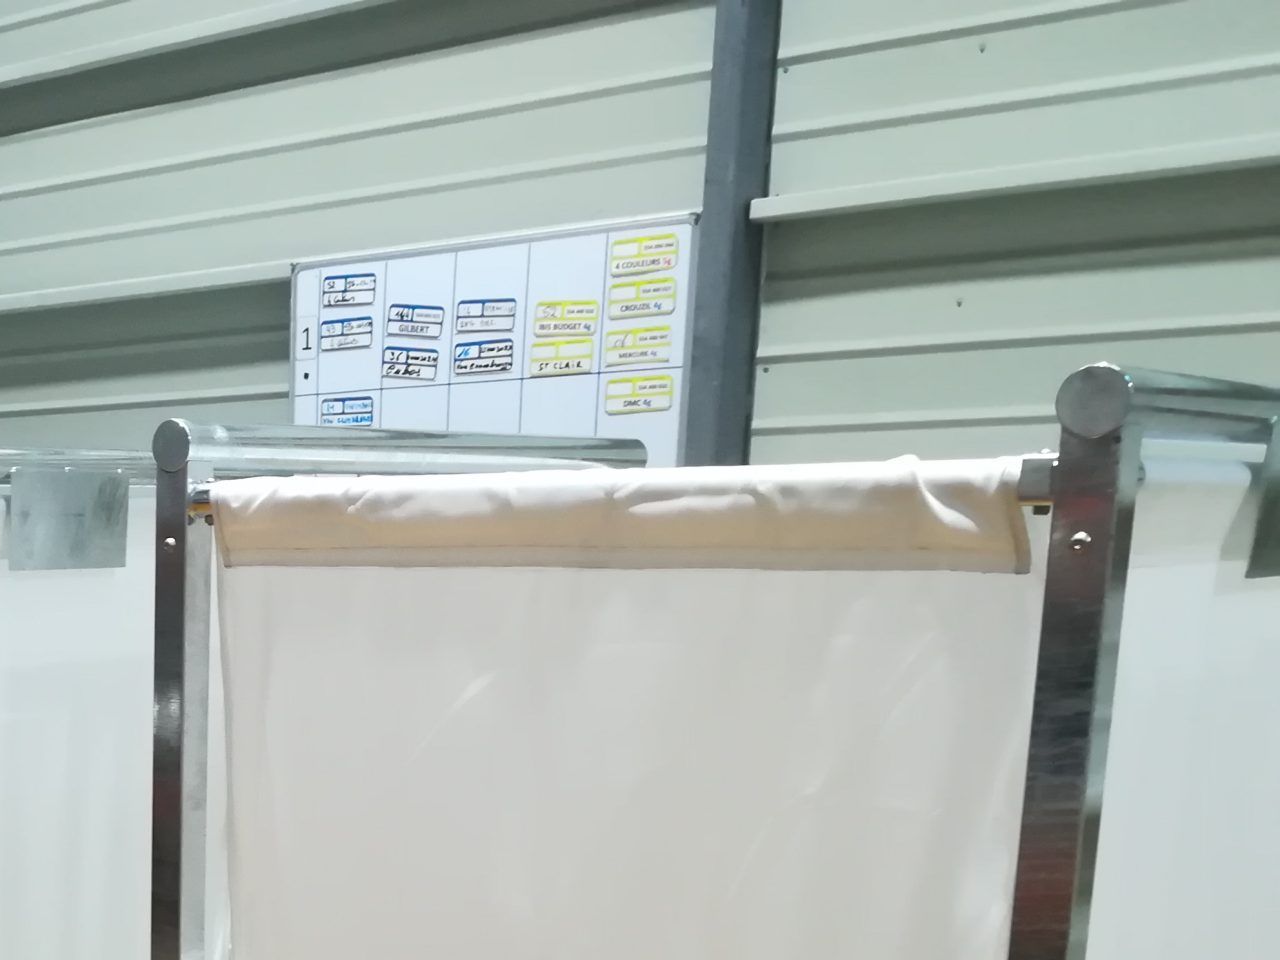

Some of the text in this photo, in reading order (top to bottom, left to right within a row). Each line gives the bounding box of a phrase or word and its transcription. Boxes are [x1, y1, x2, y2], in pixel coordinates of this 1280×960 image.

[398, 324, 430, 333] GILBERT
[553, 323, 581, 331] BUDGET
[302, 327, 312, 351] 1
